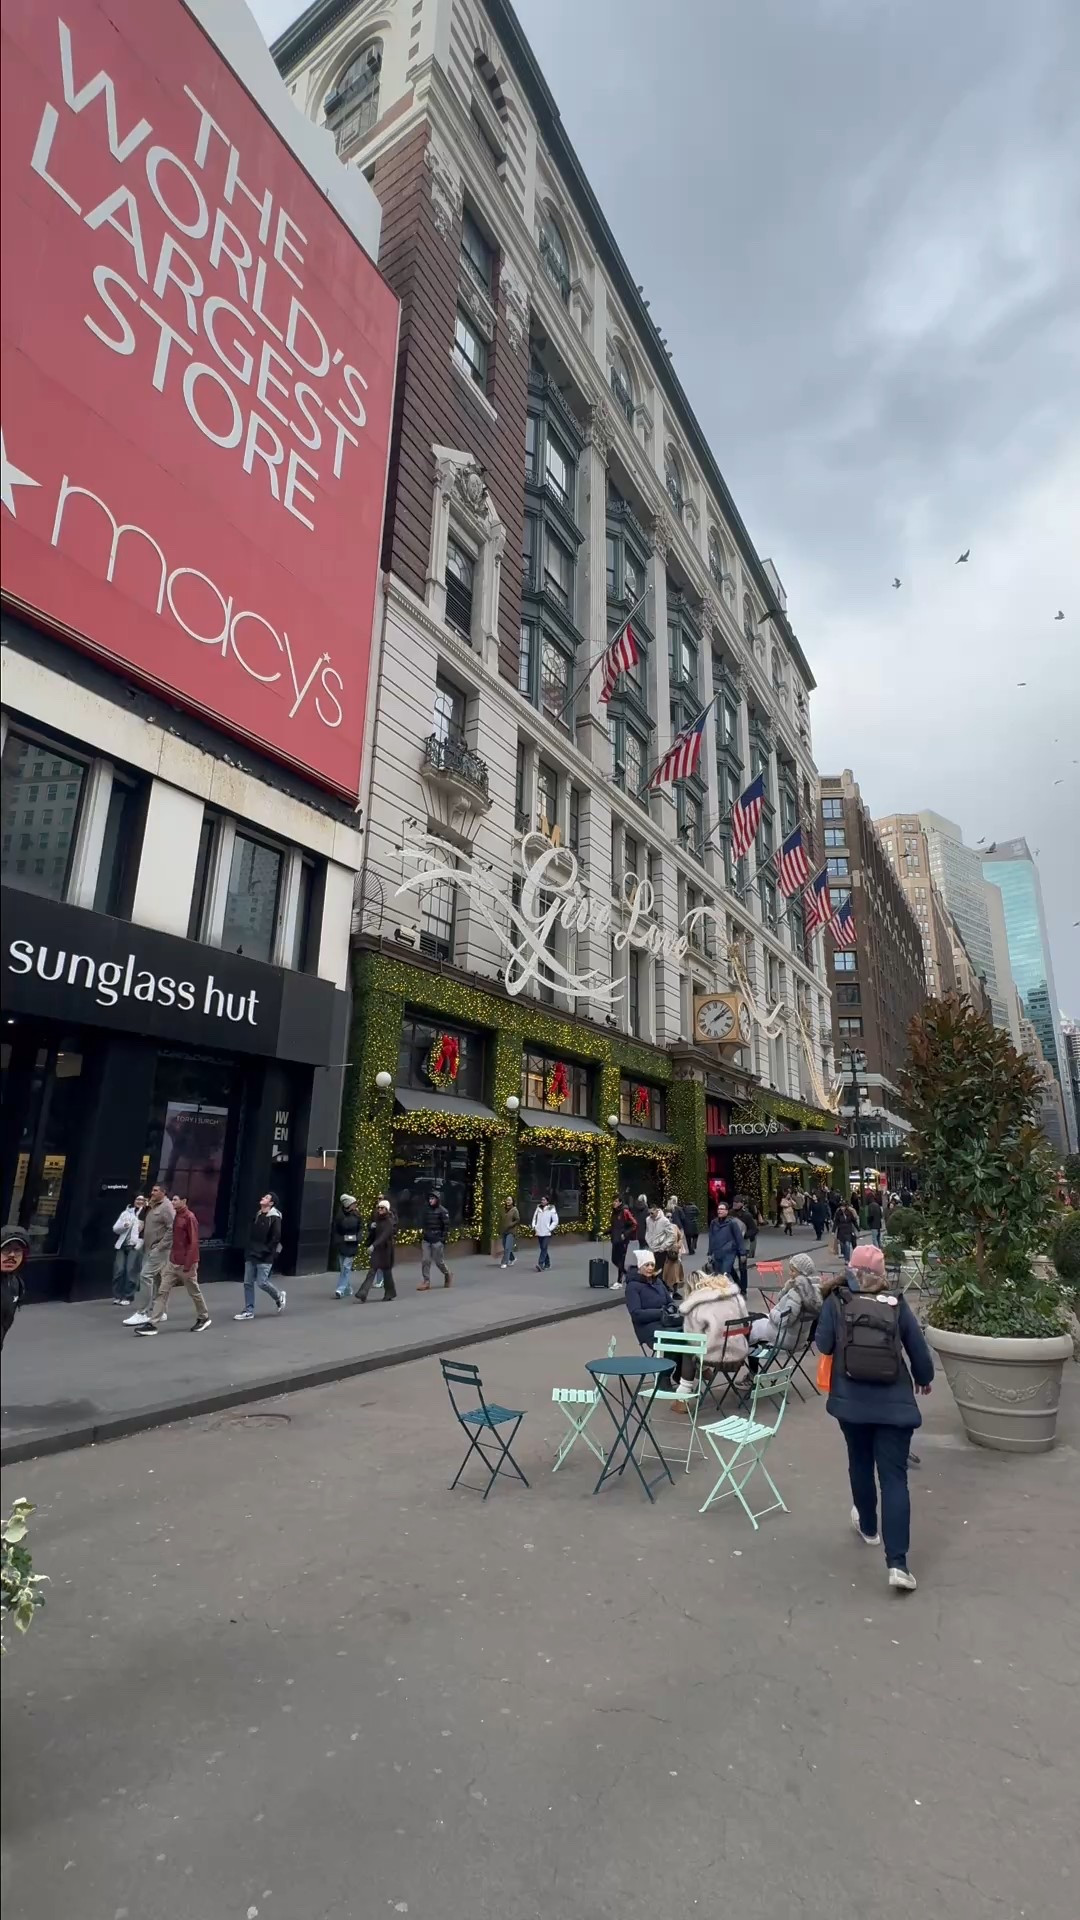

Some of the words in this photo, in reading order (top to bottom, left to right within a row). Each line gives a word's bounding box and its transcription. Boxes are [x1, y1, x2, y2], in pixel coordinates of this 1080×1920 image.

[30, 101, 359, 479] LARGEST
[58, 16, 368, 427] WORLD'S
[183, 84, 307, 290] THE
[84, 264, 320, 531] STORE
[8, 940, 196, 1010] sunglass
[203, 975, 259, 1026] hut
